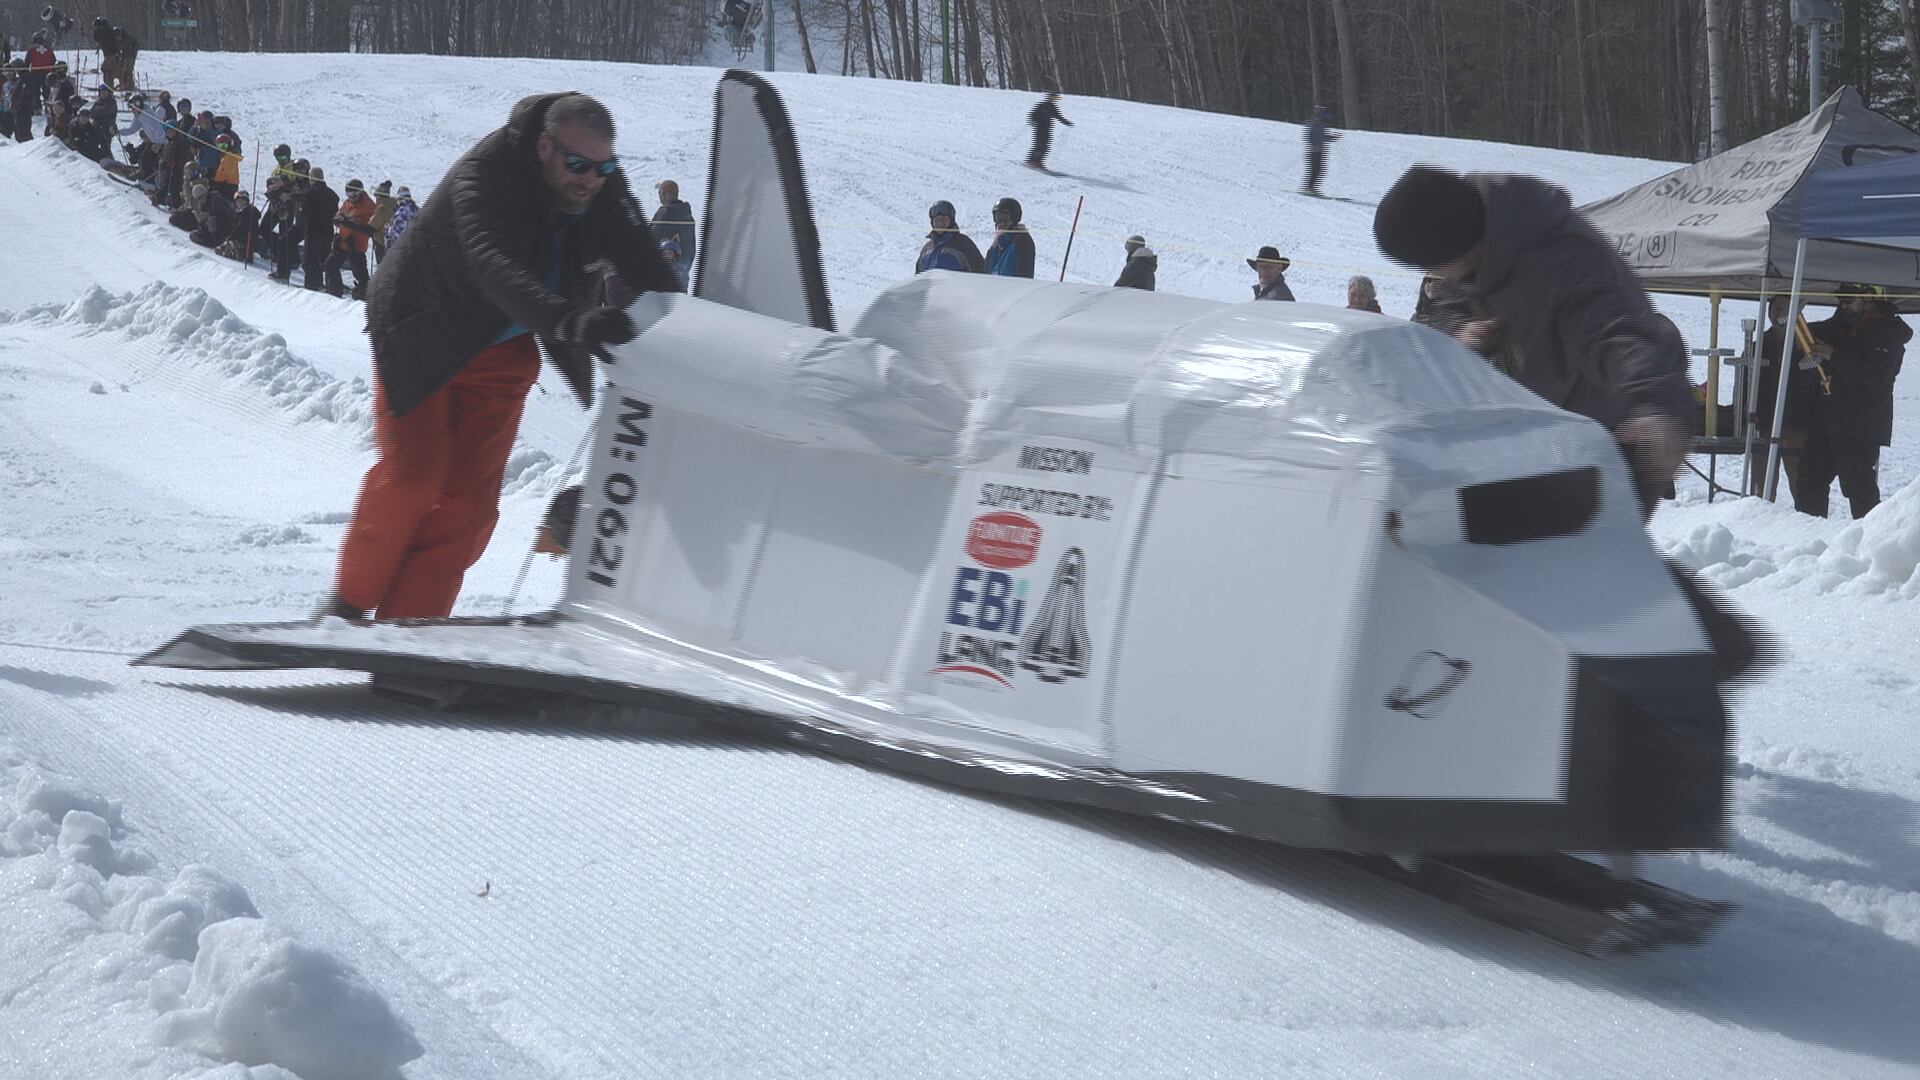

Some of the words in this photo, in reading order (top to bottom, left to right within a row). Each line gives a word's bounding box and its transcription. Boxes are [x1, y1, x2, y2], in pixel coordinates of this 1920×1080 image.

[1017, 445, 1095, 475] MISSION
[977, 483, 1081, 517] SUPPORTED
[1080, 495, 1114, 522] BY:
[937, 632, 1018, 678] LANG
